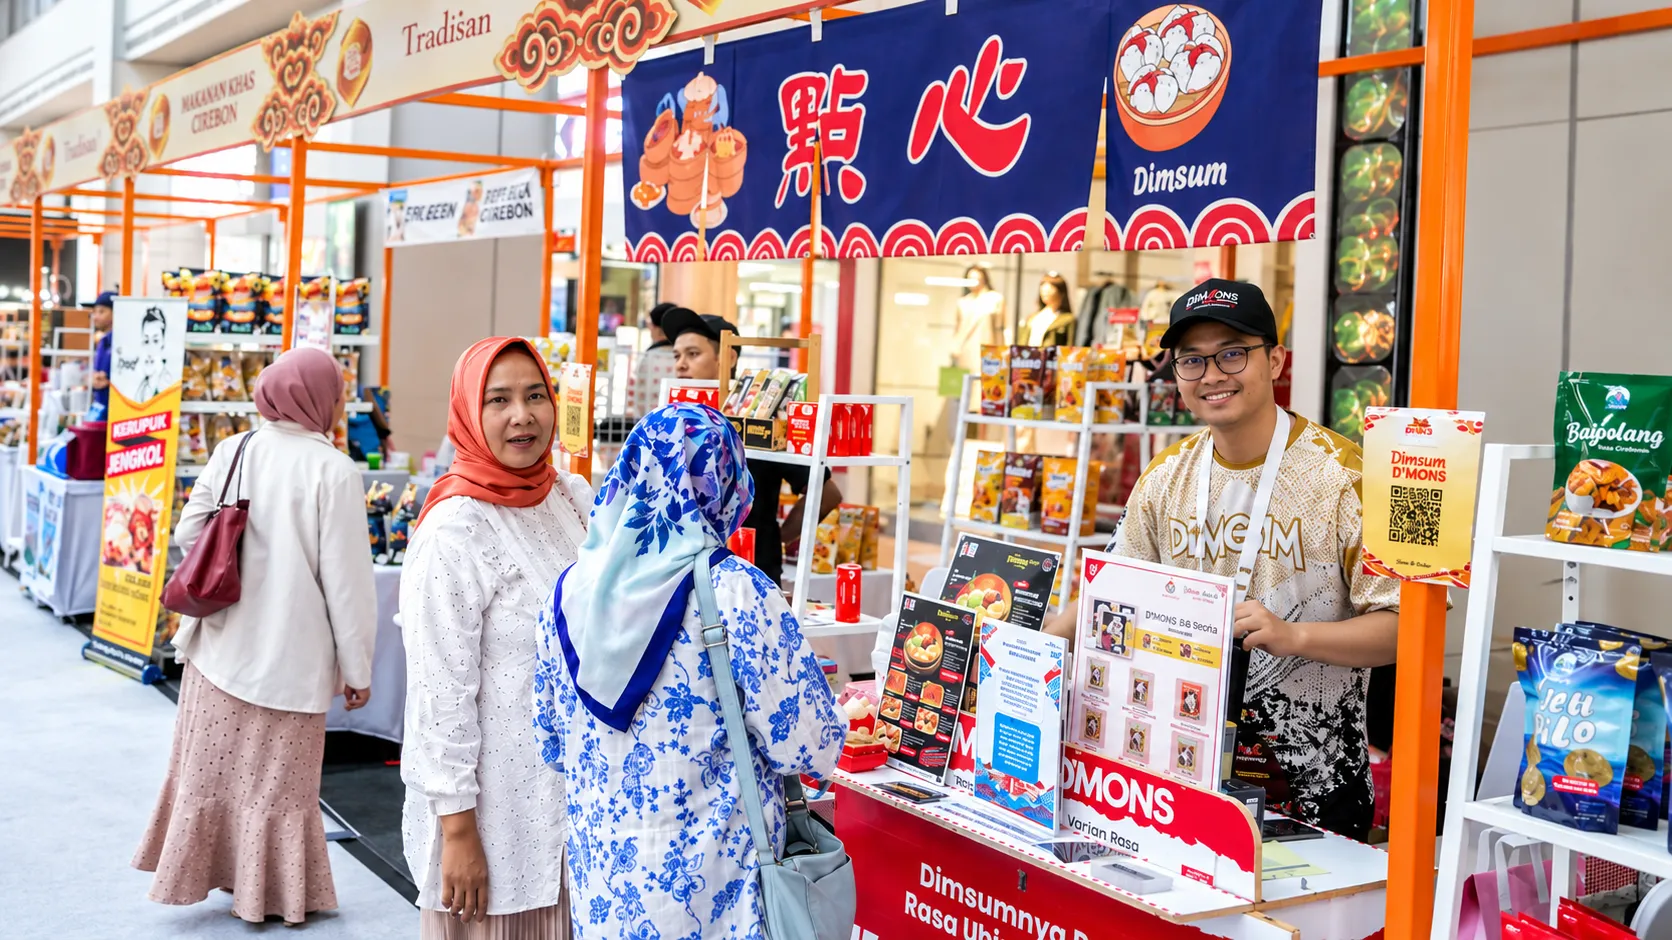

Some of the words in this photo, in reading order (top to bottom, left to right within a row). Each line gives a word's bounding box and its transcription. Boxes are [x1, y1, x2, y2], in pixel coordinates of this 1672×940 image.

[181, 81, 227, 114] MAKANAN
[228, 70, 256, 99] KHAS
[191, 102, 238, 134] CIREBON
[1132, 161, 1229, 197] Dimsum
[112, 413, 168, 439] KERUPUK
[107, 443, 164, 476] JENGKOL
[1391, 450, 1446, 469] Dimsum
[1392, 466, 1447, 483] D'MONS
[1067, 814, 1107, 841] Varian
[1110, 831, 1140, 853] Rasa
[904, 890, 958, 938] Rasa
